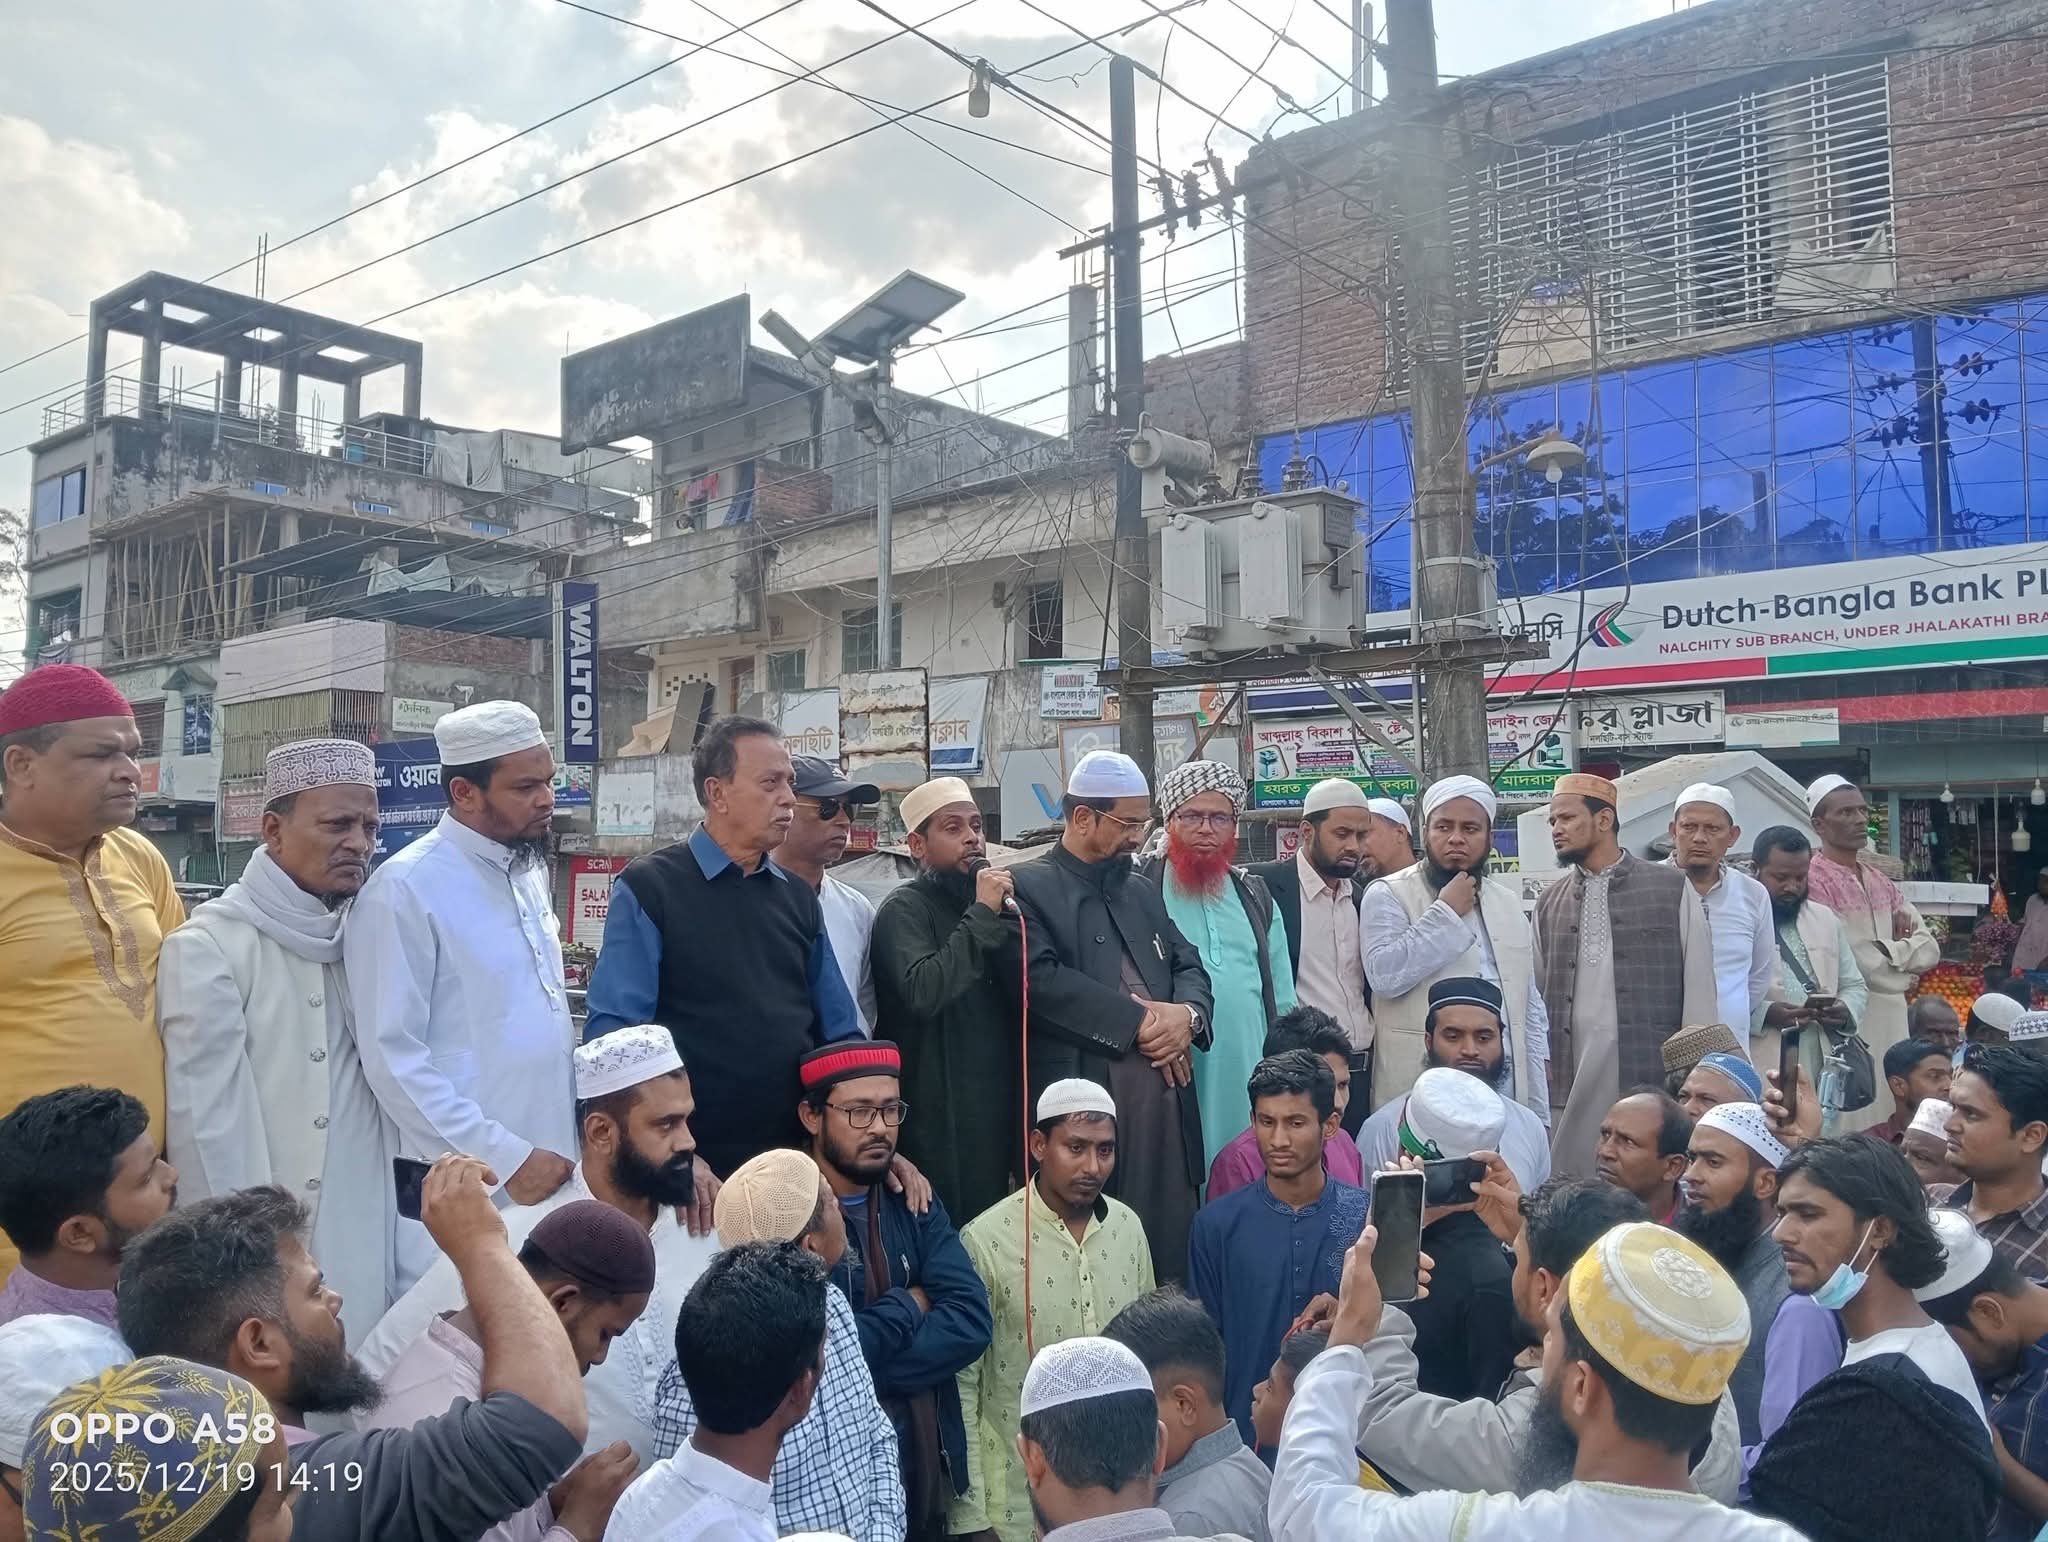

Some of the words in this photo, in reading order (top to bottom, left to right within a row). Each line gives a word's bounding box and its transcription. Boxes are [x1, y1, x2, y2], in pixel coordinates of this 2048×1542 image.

[1663, 585, 1895, 629] Dutch-Bangla
[1910, 573, 2004, 607] Bank
[1659, 638, 1731, 655] NALCHITY
[1736, 635, 1765, 648] SUB
[1770, 630, 1839, 646] BRANCH,
[1844, 624, 1900, 640] UNDER
[1905, 615, 2010, 634] JHALAKATHI
[570, 602, 593, 745] WALTON
[1307, 725, 1344, 740] বিকাশ
[1487, 714, 1528, 731] নলাইন
[1630, 700, 1715, 730] প্লাজা
[784, 726, 834, 754] নলছিটি
[400, 764, 441, 789] ওয়াল
[1263, 783, 1302, 797] হযরত
[581, 888, 611, 902] SALA
[584, 905, 609, 919] STEE
